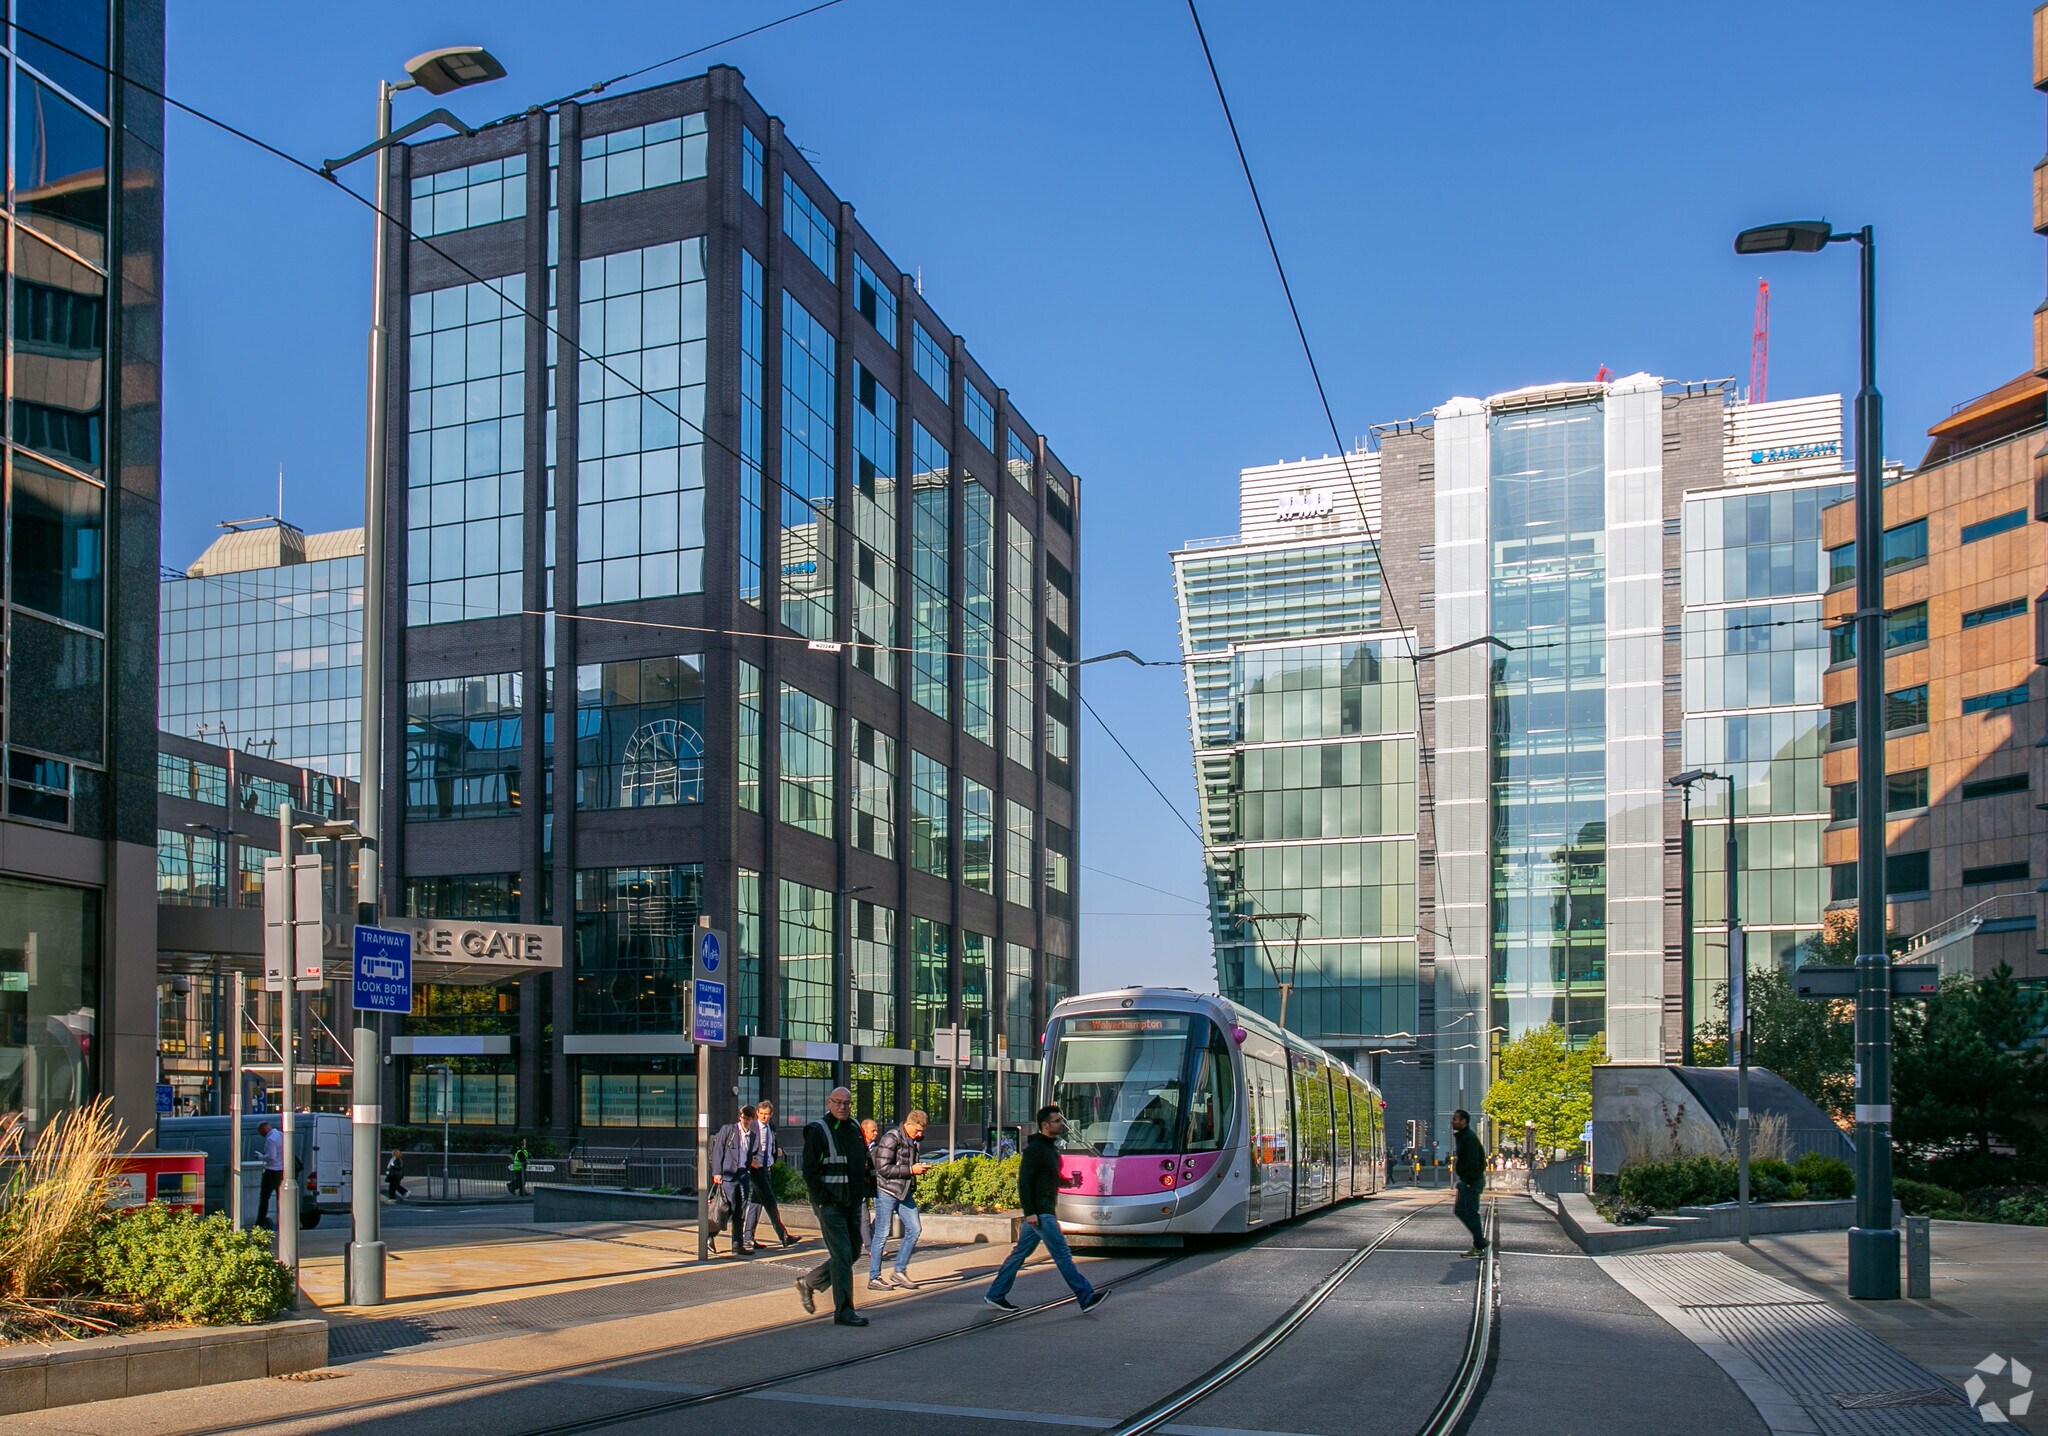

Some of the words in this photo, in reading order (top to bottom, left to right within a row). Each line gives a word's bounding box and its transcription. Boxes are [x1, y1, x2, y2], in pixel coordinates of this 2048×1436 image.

[1768, 441, 1837, 462] BARCLAYS
[361, 932, 404, 947] TRAMWAY
[460, 929, 542, 960] GATE
[357, 981, 382, 993] LOOK
[384, 983, 408, 995] BOTH
[699, 984, 722, 994] TRAMWAY
[370, 994, 396, 1006] WAYS
[696, 1019, 710, 1027] LOOK
[710, 1021, 723, 1029] BOTH
[1092, 1020, 1163, 1030] Wolverhampton
[703, 1029, 717, 1037] WAYS
[109, 1176, 132, 1188] GVA
